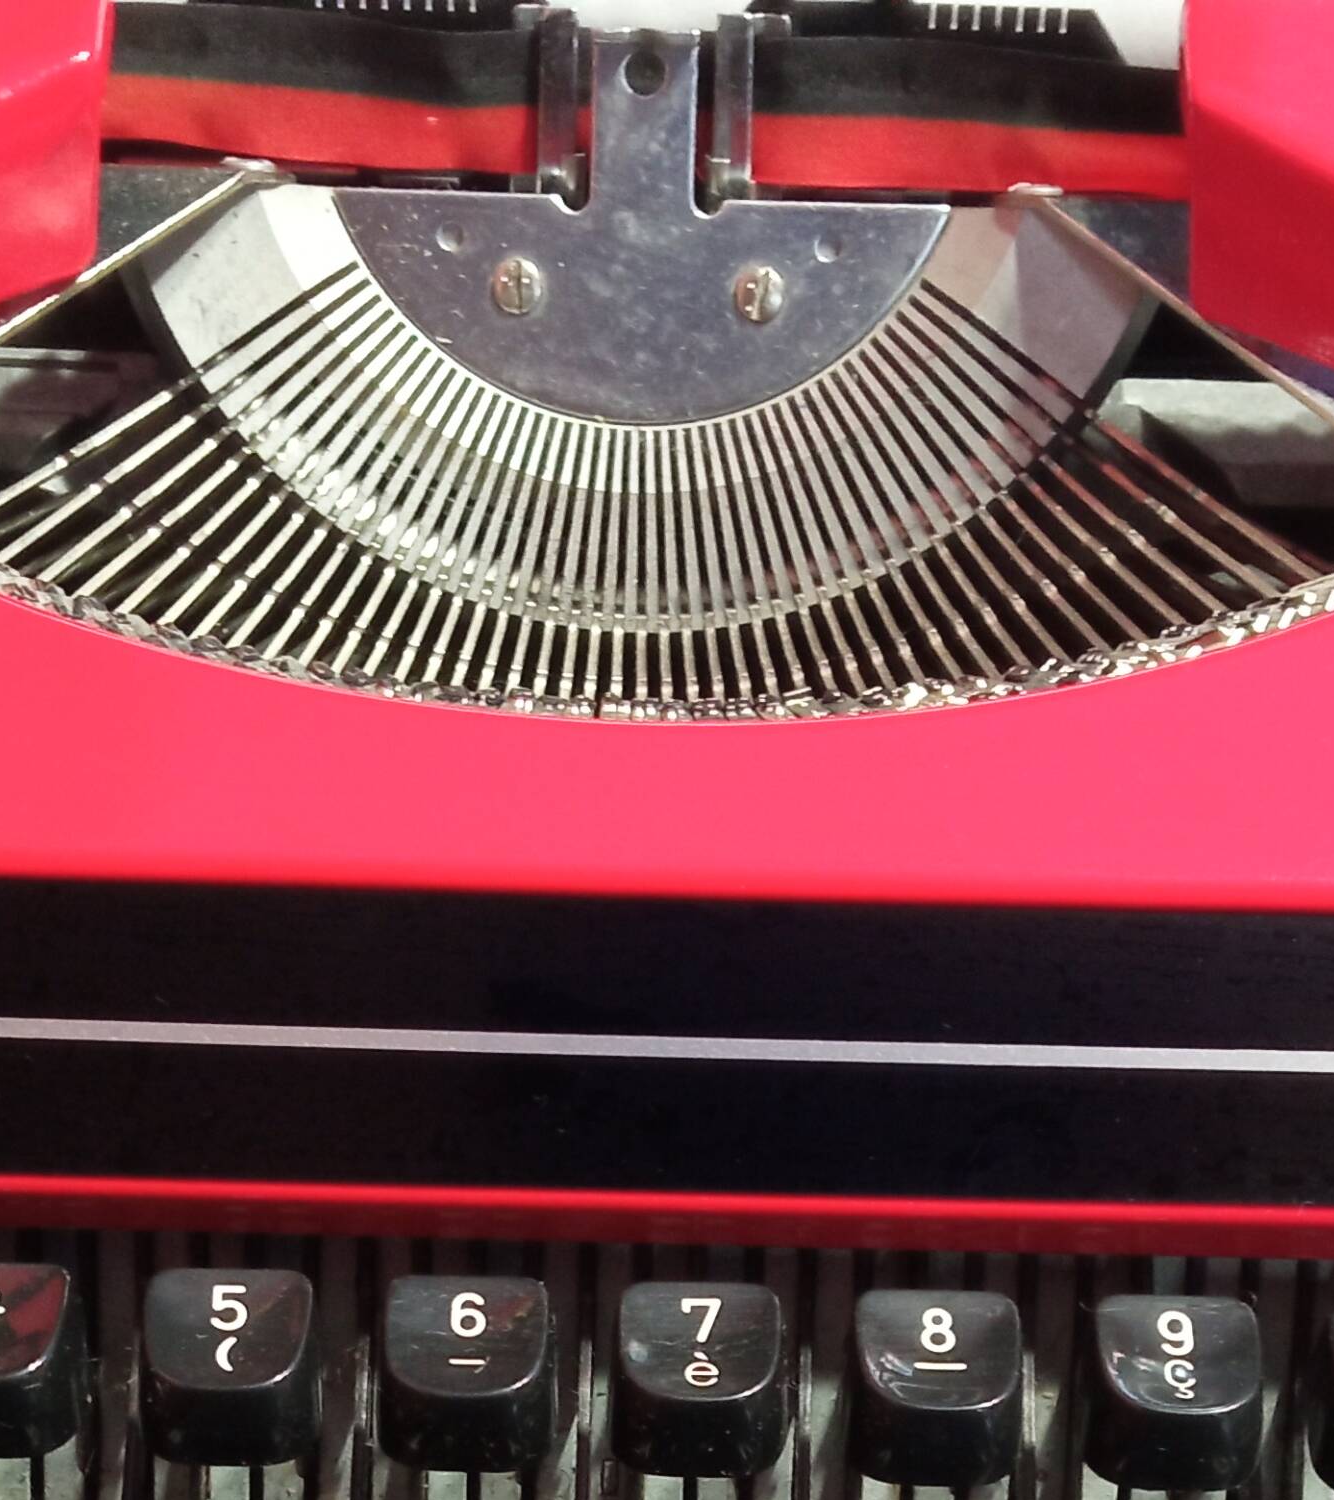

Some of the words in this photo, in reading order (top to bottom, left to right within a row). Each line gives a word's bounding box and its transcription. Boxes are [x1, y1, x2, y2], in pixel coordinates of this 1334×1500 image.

[210, 1285, 249, 1332] 5
[450, 1292, 487, 1338] 6
[680, 1297, 723, 1343] 7
[919, 1308, 957, 1354] 8
[1156, 1310, 1195, 1357] 9
[683, 1351, 720, 1387] è
